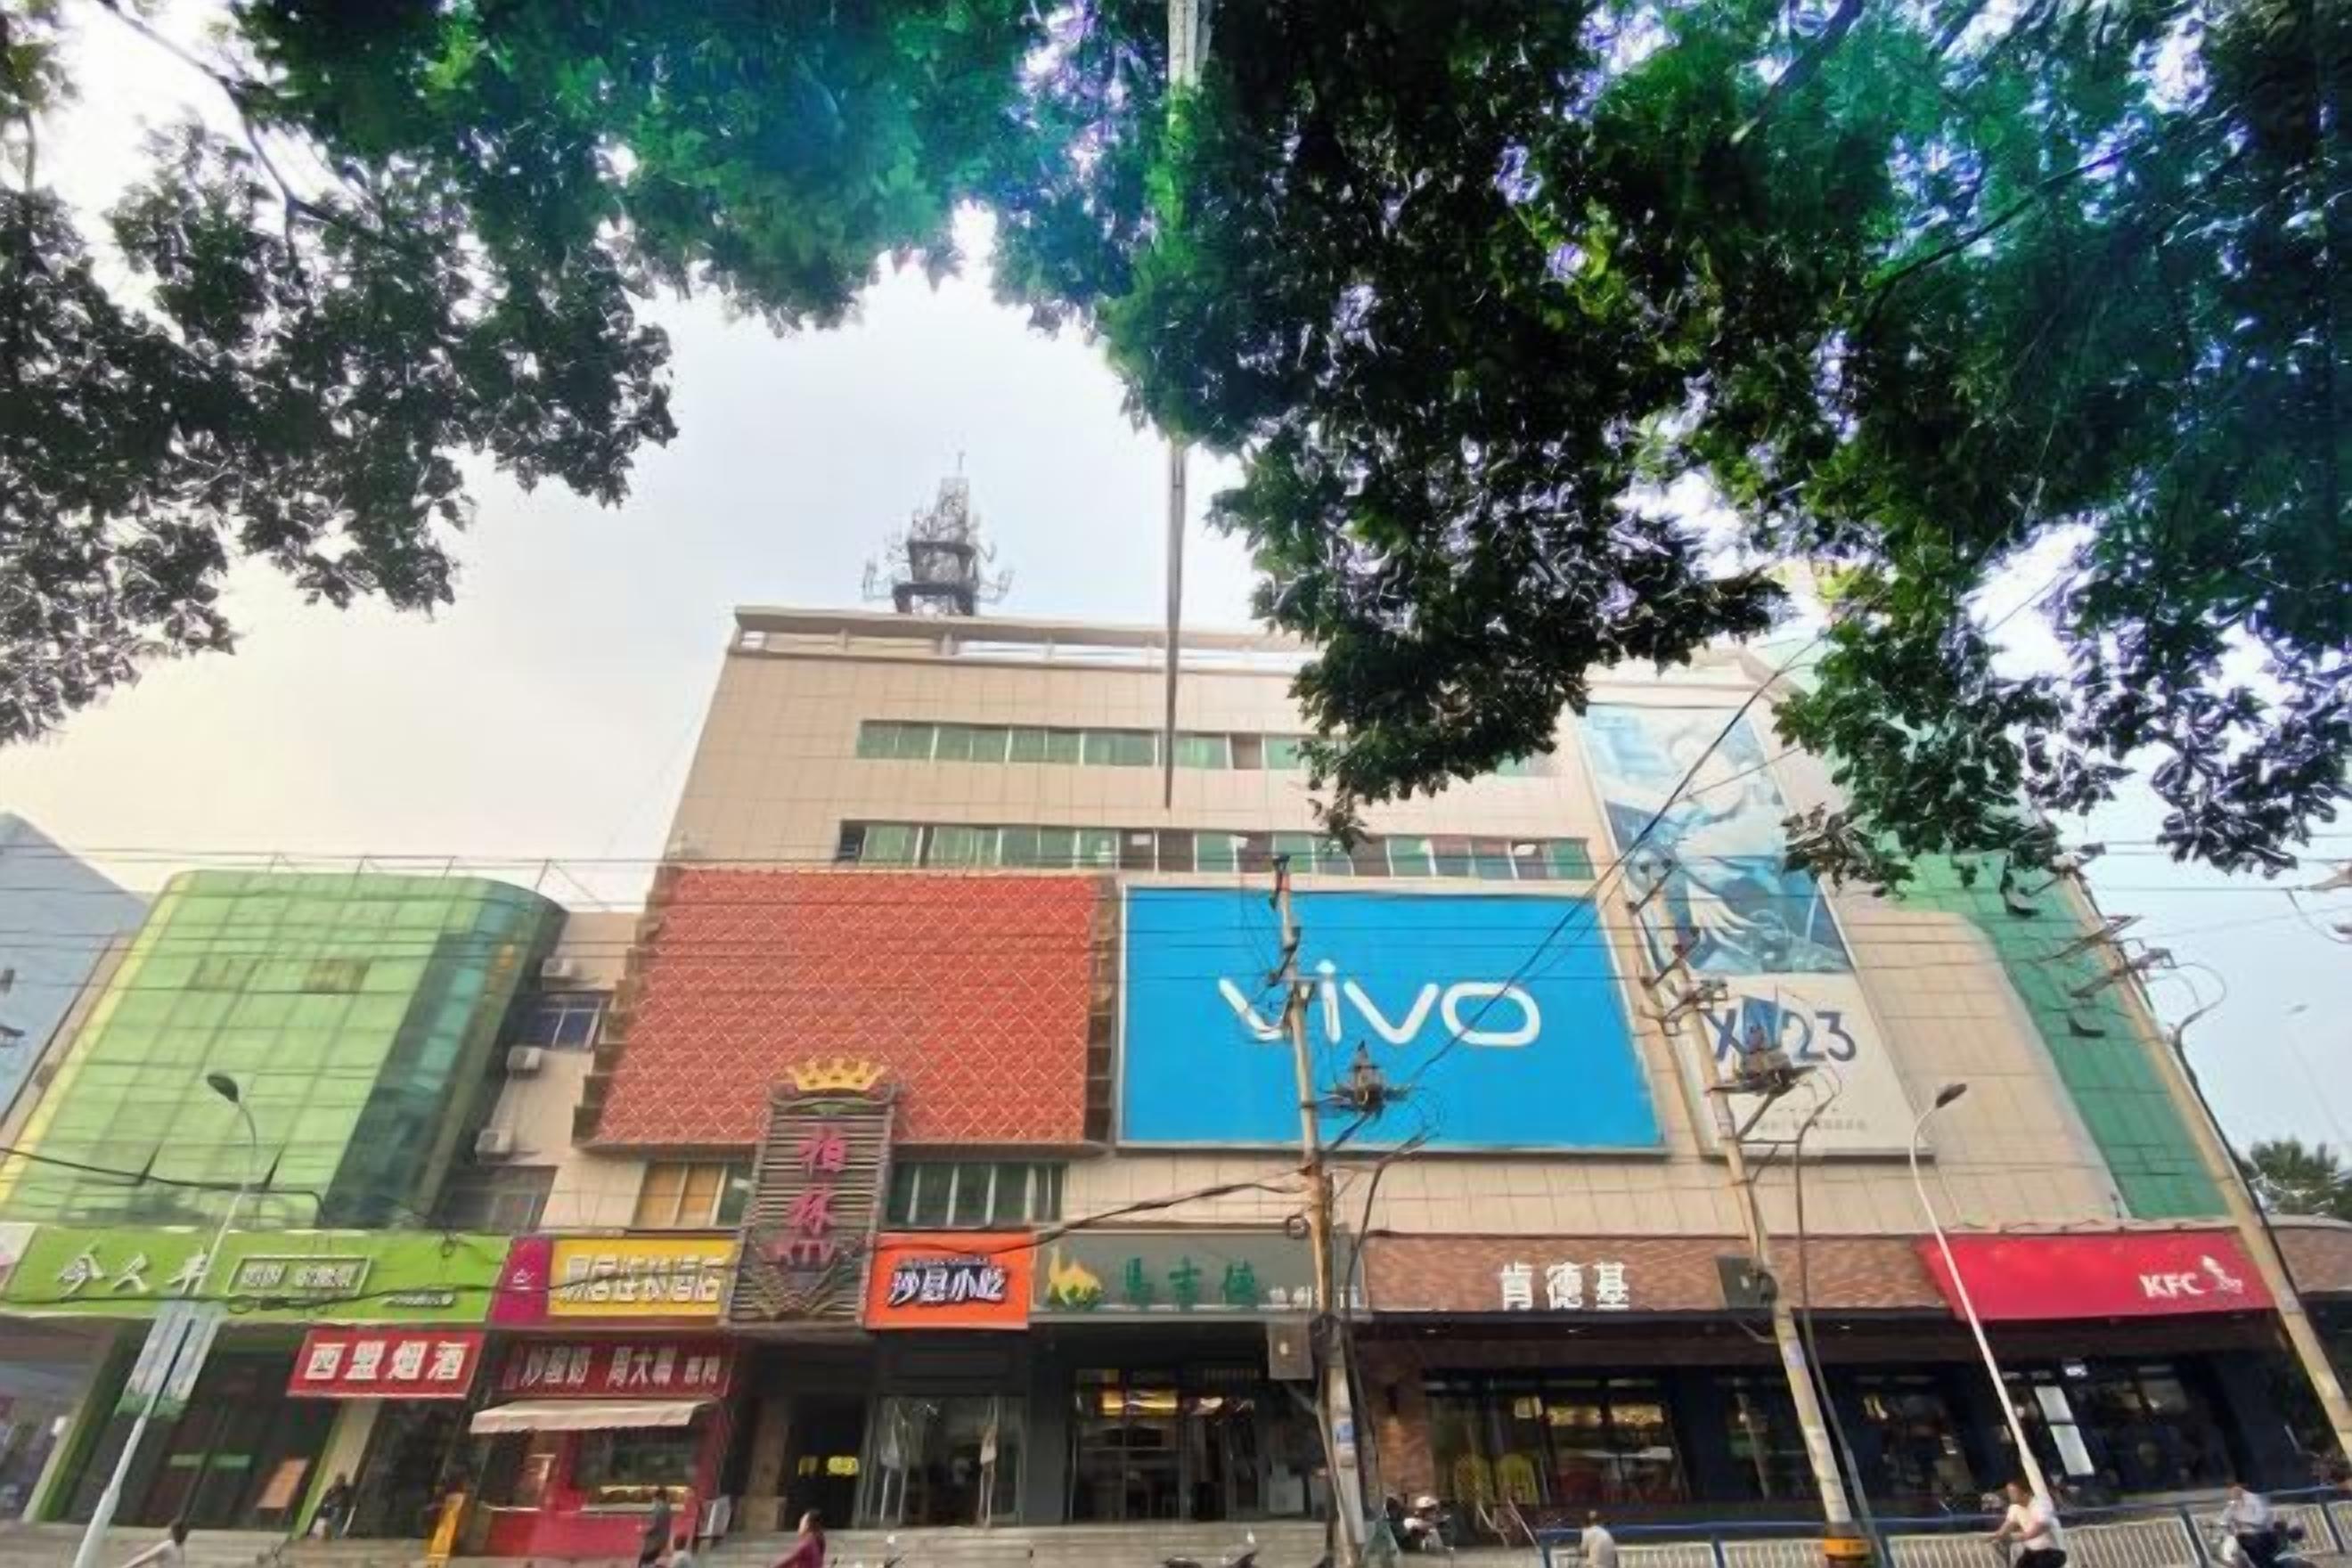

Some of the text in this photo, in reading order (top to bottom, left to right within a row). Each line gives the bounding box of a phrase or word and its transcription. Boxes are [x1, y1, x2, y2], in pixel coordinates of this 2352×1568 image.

[1218, 959, 1540, 1047] vivo
[1500, 1262, 1629, 1311] 肯德基
[2139, 1272, 2205, 1298] KFC
